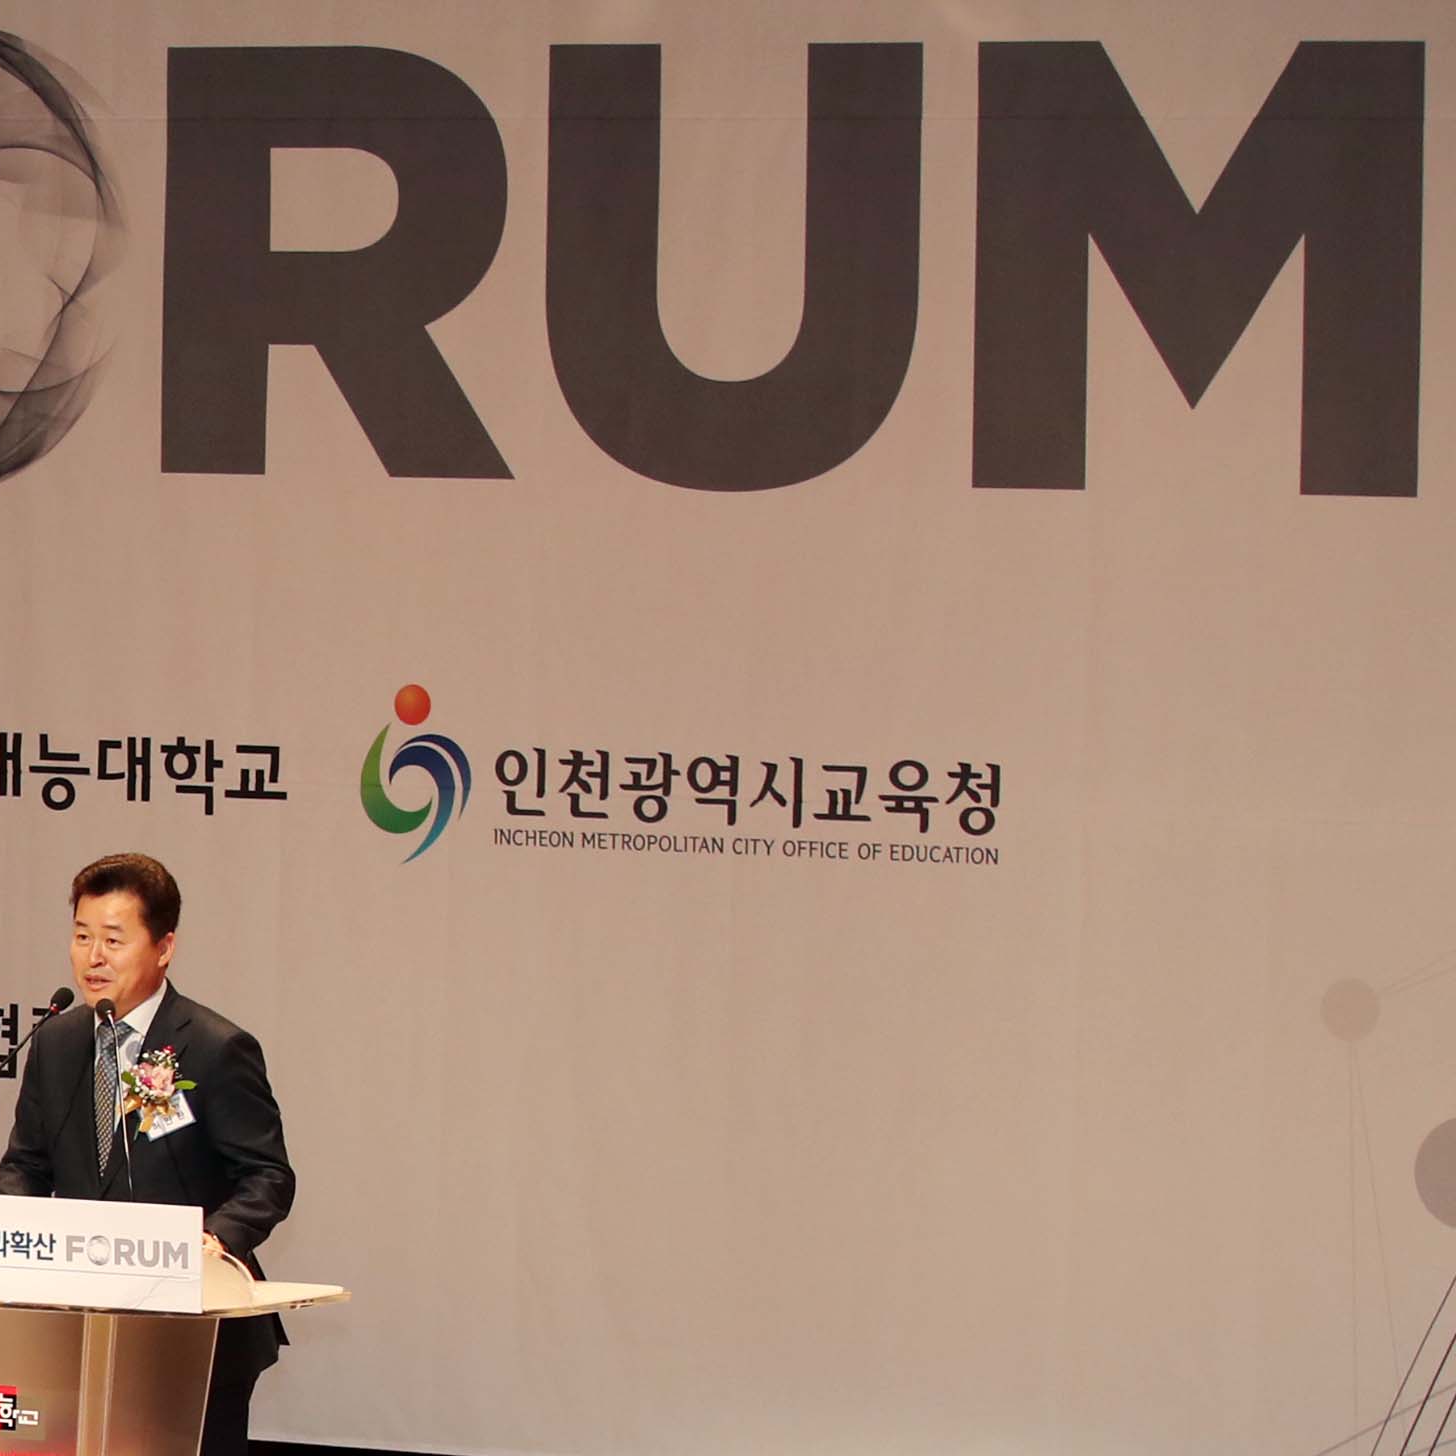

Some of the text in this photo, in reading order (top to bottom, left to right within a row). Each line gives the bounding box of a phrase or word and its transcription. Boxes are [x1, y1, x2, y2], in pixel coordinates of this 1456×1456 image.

[494, 747, 1001, 836] 인천광역시교육청
[493, 828, 999, 865] INCHEON METROPOLITAN CITY OFFICE OF EDUCATION
[65, 1235, 189, 1269] FORUM
